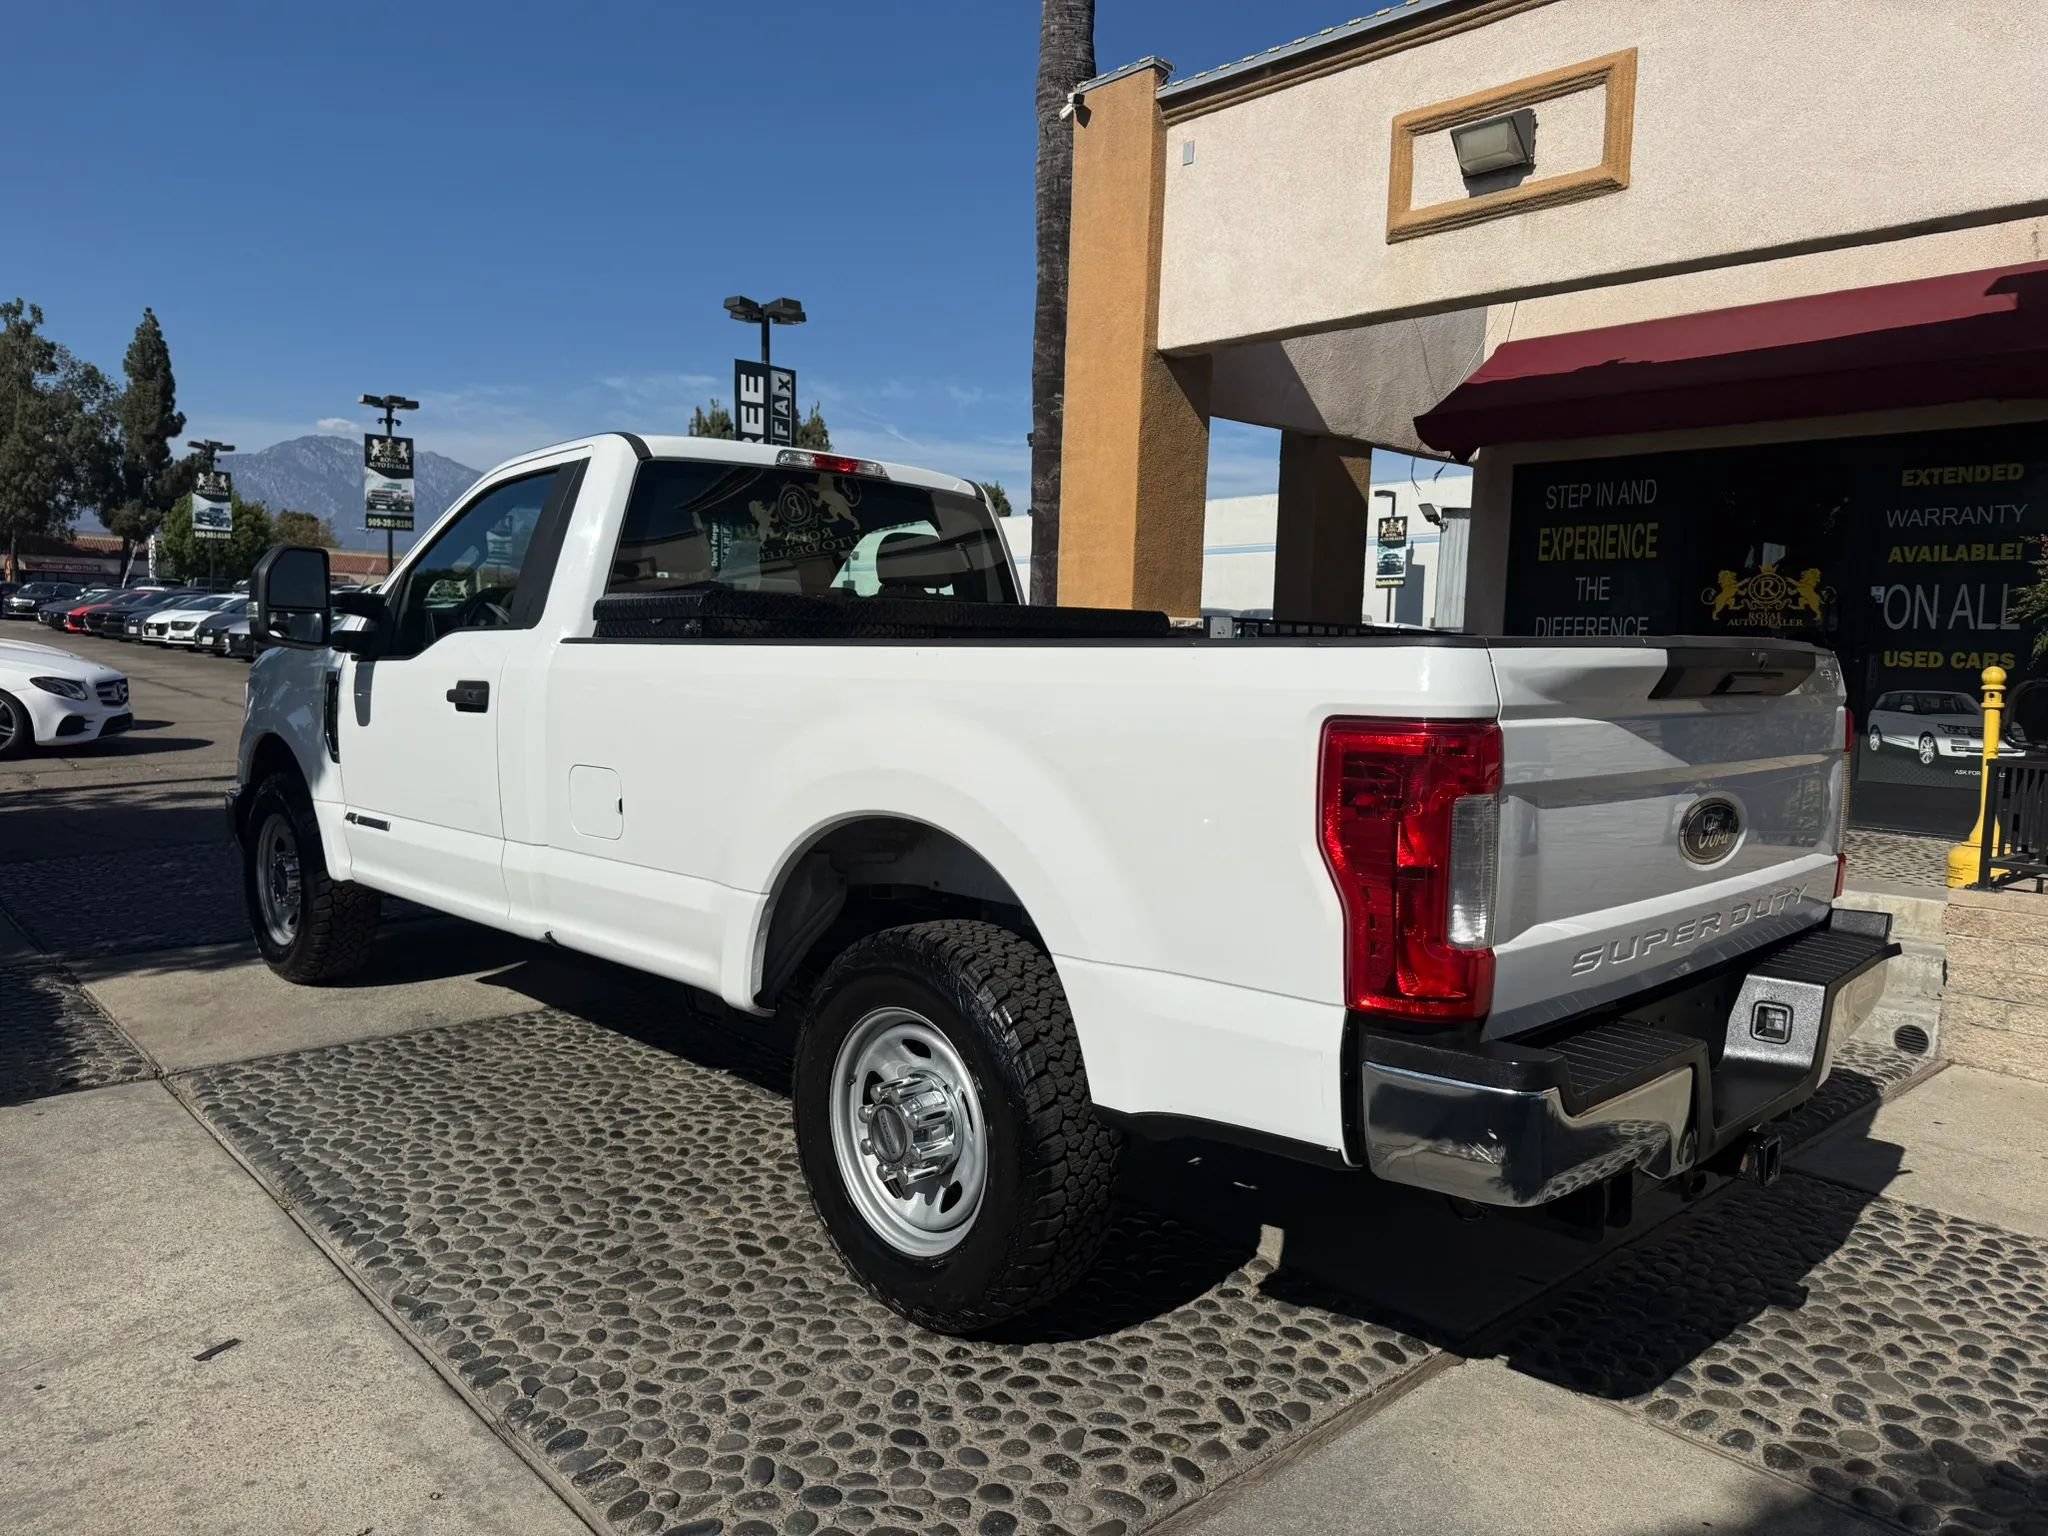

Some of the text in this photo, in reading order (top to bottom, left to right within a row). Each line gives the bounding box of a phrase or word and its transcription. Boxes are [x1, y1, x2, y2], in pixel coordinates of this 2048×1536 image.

[740, 373, 764, 443] EE
[774, 376, 791, 446] FAX
[1901, 463, 2024, 487] EXTENDED
[1546, 479, 1657, 509] STEP IN AND
[1886, 504, 2028, 528] WARRANTY
[1538, 522, 1659, 561] EXPERIENCE
[1888, 543, 2024, 563] AVAILABLE!
[1576, 576, 1611, 600] THE
[1760, 580, 1775, 596] R
[1749, 611, 1782, 620] ROYAL
[1884, 584, 2020, 630] ON ALL
[1536, 616, 1648, 637] DIFFERENCE
[1759, 619, 1803, 627] DEALER
[1884, 651, 2016, 669] USED CARS
[1571, 883, 1807, 976] SUPER DUTY
